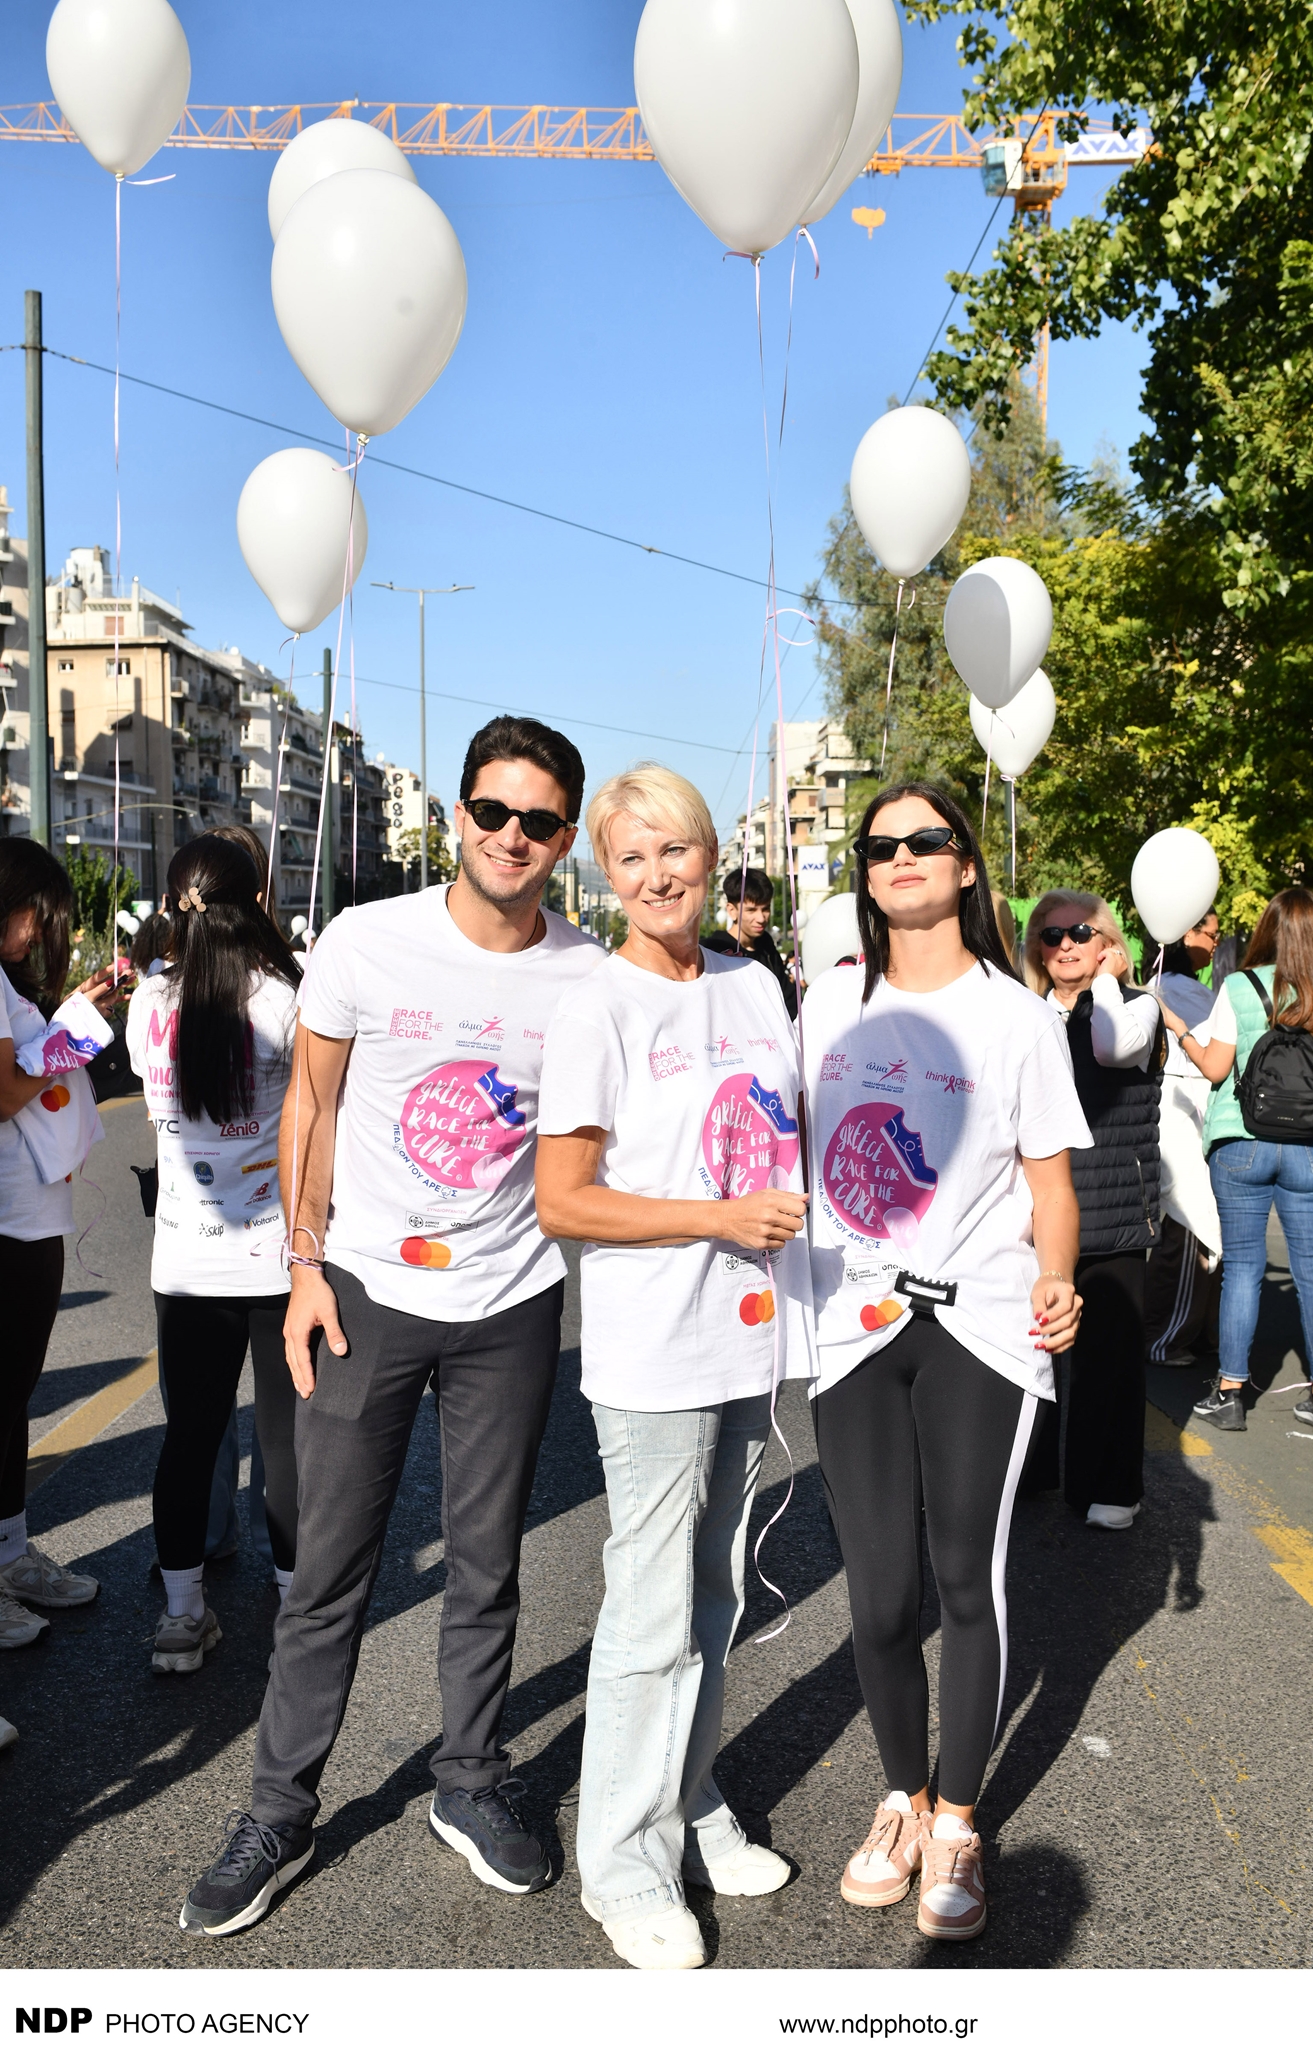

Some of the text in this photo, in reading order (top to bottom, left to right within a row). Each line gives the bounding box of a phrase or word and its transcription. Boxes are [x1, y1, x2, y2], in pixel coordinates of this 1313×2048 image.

[1072, 138, 1139, 155] AVAX
[400, 1009, 433, 1020] RACE
[399, 1019, 444, 1031] FOR THE
[523, 1028, 545, 1041] think
[651, 1046, 681, 1061] RACE
[655, 1057, 677, 1070] FOR
[676, 1052, 696, 1063] THE
[825, 1054, 847, 1063] RACE
[825, 1063, 853, 1072] FOR THE
[925, 1070, 976, 1090] think pink
[416, 1076, 480, 1115] GREECE
[407, 1107, 492, 1133] RACE FOR
[711, 1094, 754, 1135] GREECE
[155, 1118, 180, 1134] TC
[750, 1131, 772, 1147] FOR
[837, 1120, 885, 1161] GREECE
[411, 1132, 490, 1177] CURE THE
[711, 1137, 746, 1166] RACE
[747, 1150, 773, 1169] THE
[408, 1162, 423, 1179] ΤΟΥ
[830, 1155, 900, 1181] RACE FOR
[253, 1195, 272, 1203] balance
[834, 1182, 896, 1227] CURE THE
[252, 1213, 280, 1227] Voltarol
[833, 1217, 849, 1233] ΤΟΥ
